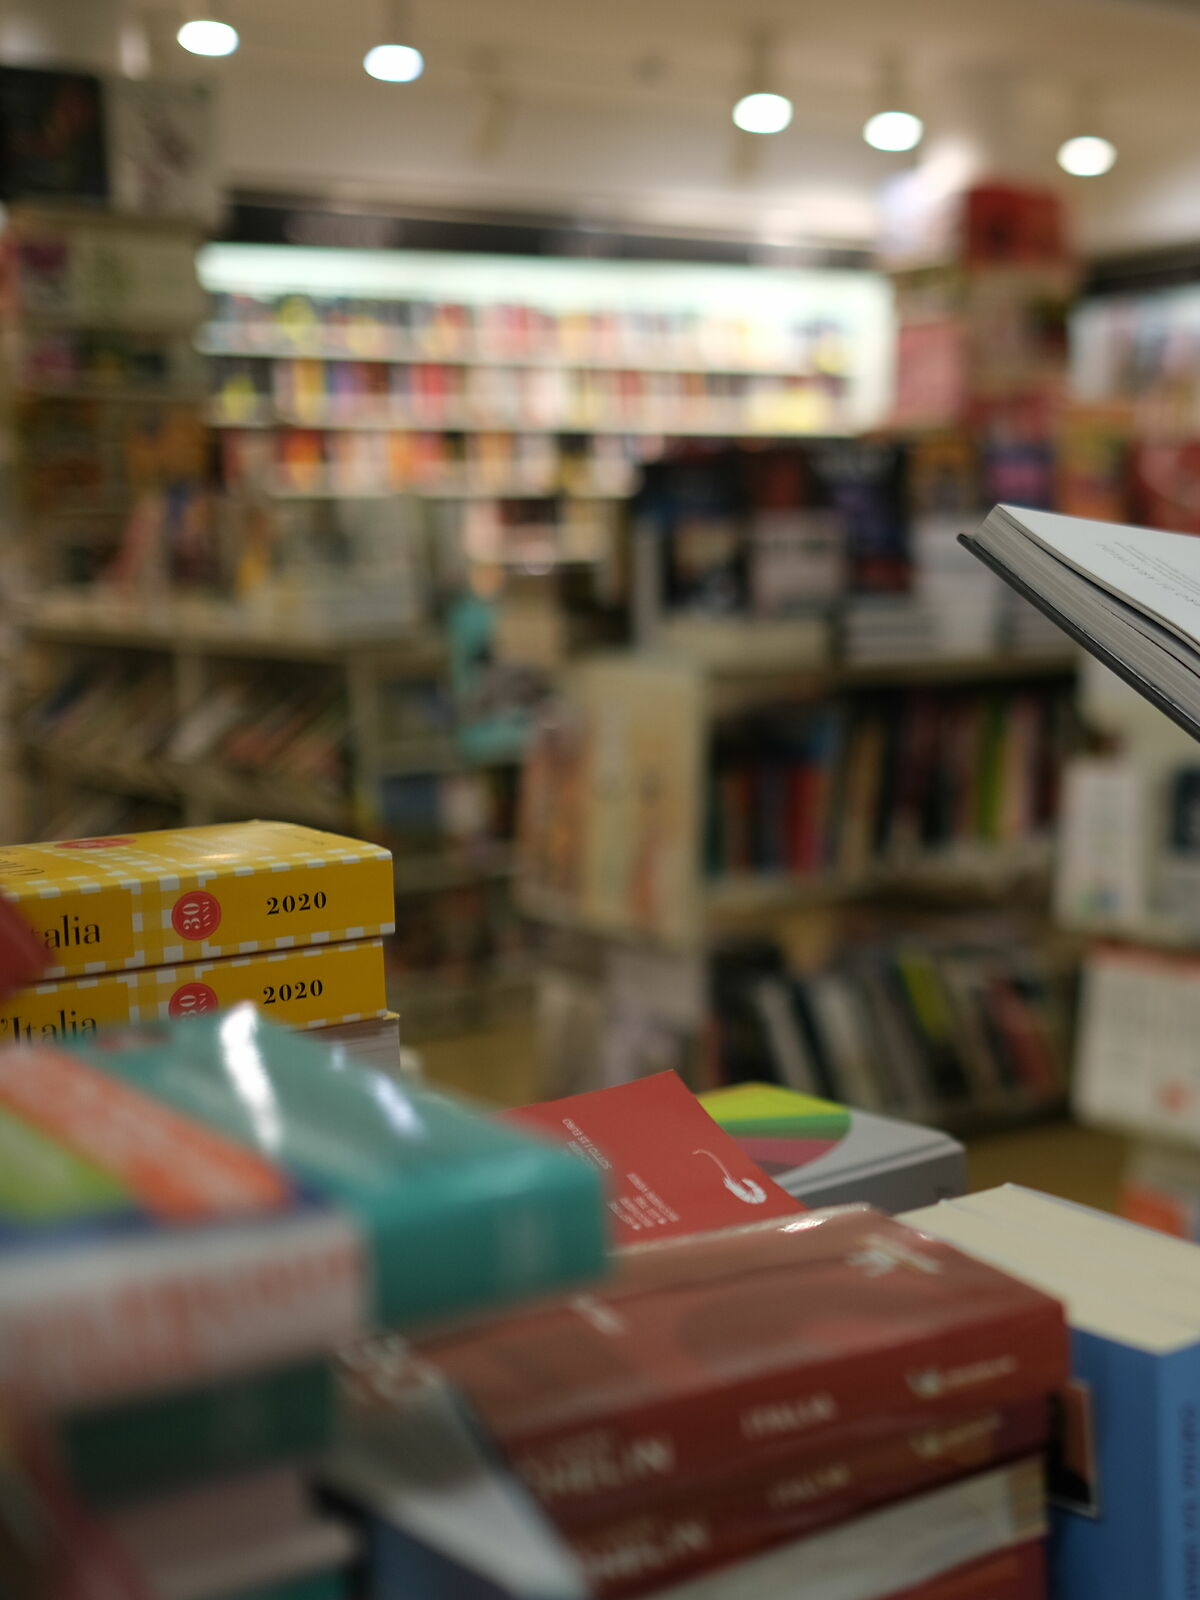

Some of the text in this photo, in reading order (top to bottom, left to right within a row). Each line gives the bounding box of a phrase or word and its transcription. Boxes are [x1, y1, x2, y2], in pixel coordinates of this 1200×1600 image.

[266, 891, 327, 915] 2020
[182, 903, 201, 930] 30
[263, 979, 324, 1005] 2020
